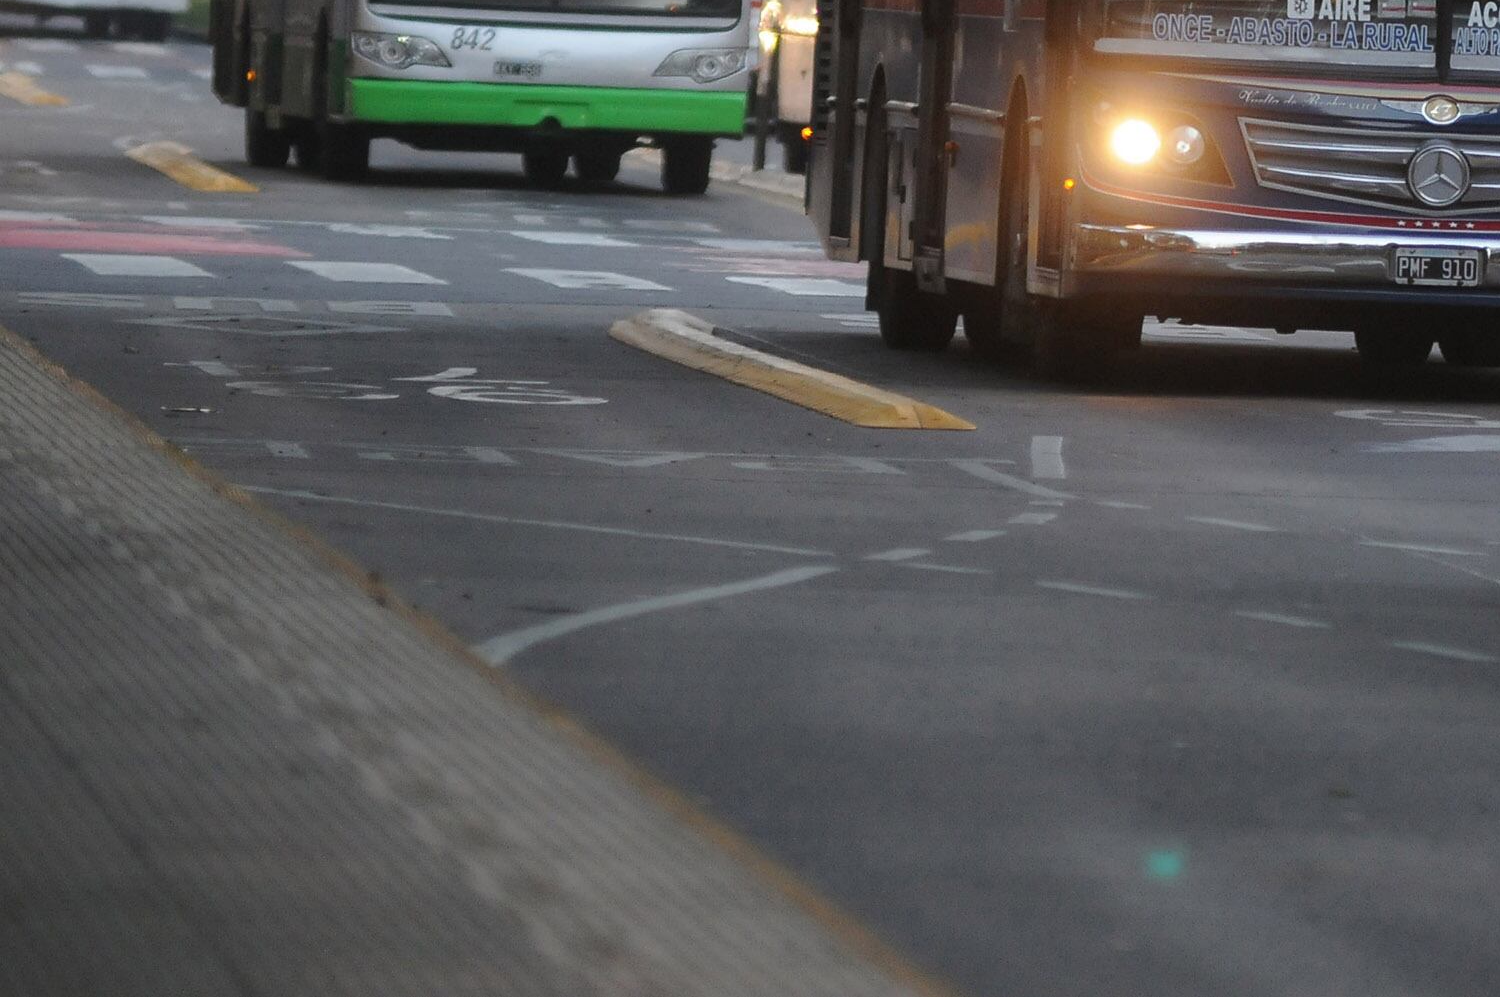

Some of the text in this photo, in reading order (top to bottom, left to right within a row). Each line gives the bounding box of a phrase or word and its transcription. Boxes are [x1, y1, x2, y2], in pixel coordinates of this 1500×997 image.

[451, 27, 496, 51] 842
[1152, 13, 1213, 42] ONCE
[1227, 17, 1315, 47] ABASTO
[1330, 21, 1358, 50] LA
[1362, 22, 1434, 53] RURAL
[1454, 28, 1488, 55] ALTO
[1399, 257, 1475, 281] PMF 910
